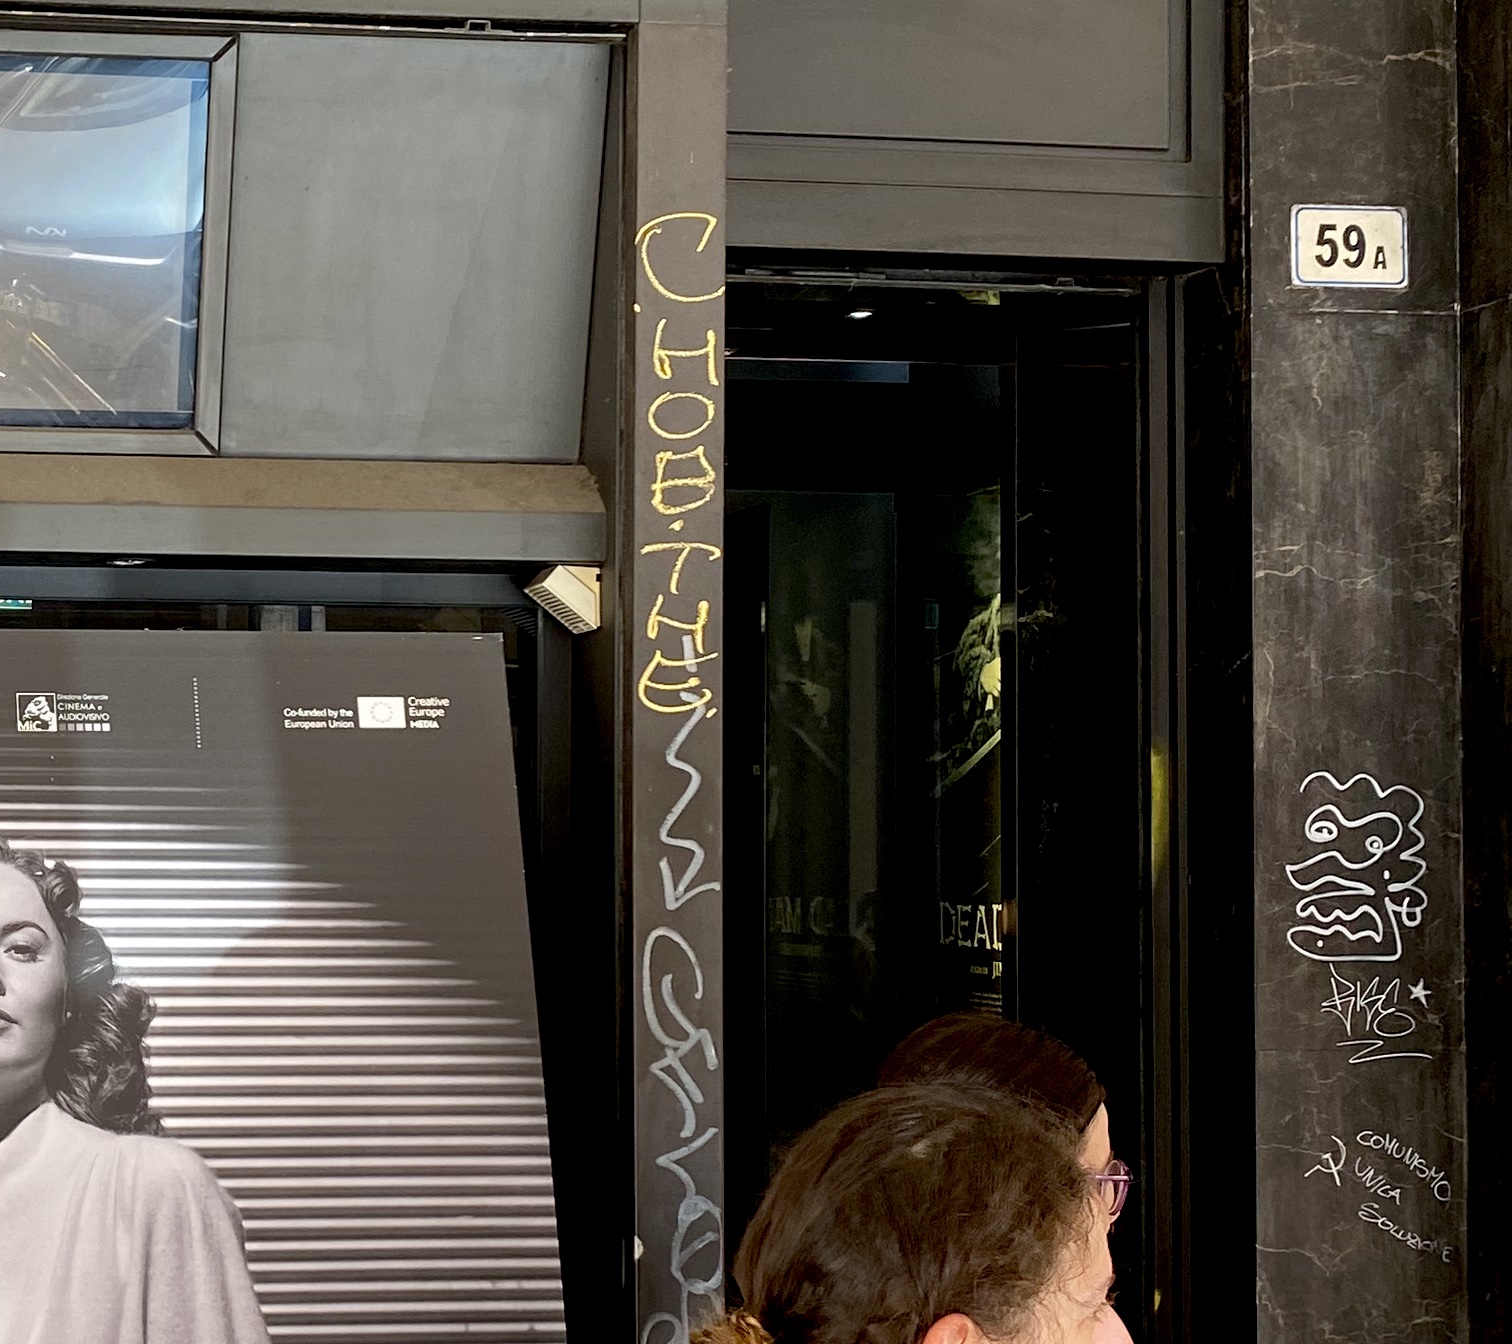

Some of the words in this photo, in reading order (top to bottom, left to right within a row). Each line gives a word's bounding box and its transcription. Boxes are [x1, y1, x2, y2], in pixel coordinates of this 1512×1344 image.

[1315, 223, 1366, 269] 59
[57, 702, 96, 711] CINEMA
[407, 696, 450, 707] Creative
[58, 713, 110, 721] AUDIOVISIVO
[327, 708, 338, 719] by
[339, 709, 354, 718] the
[408, 707, 445, 718] Europe
[284, 719, 327, 731] European
[328, 719, 355, 729] Union
